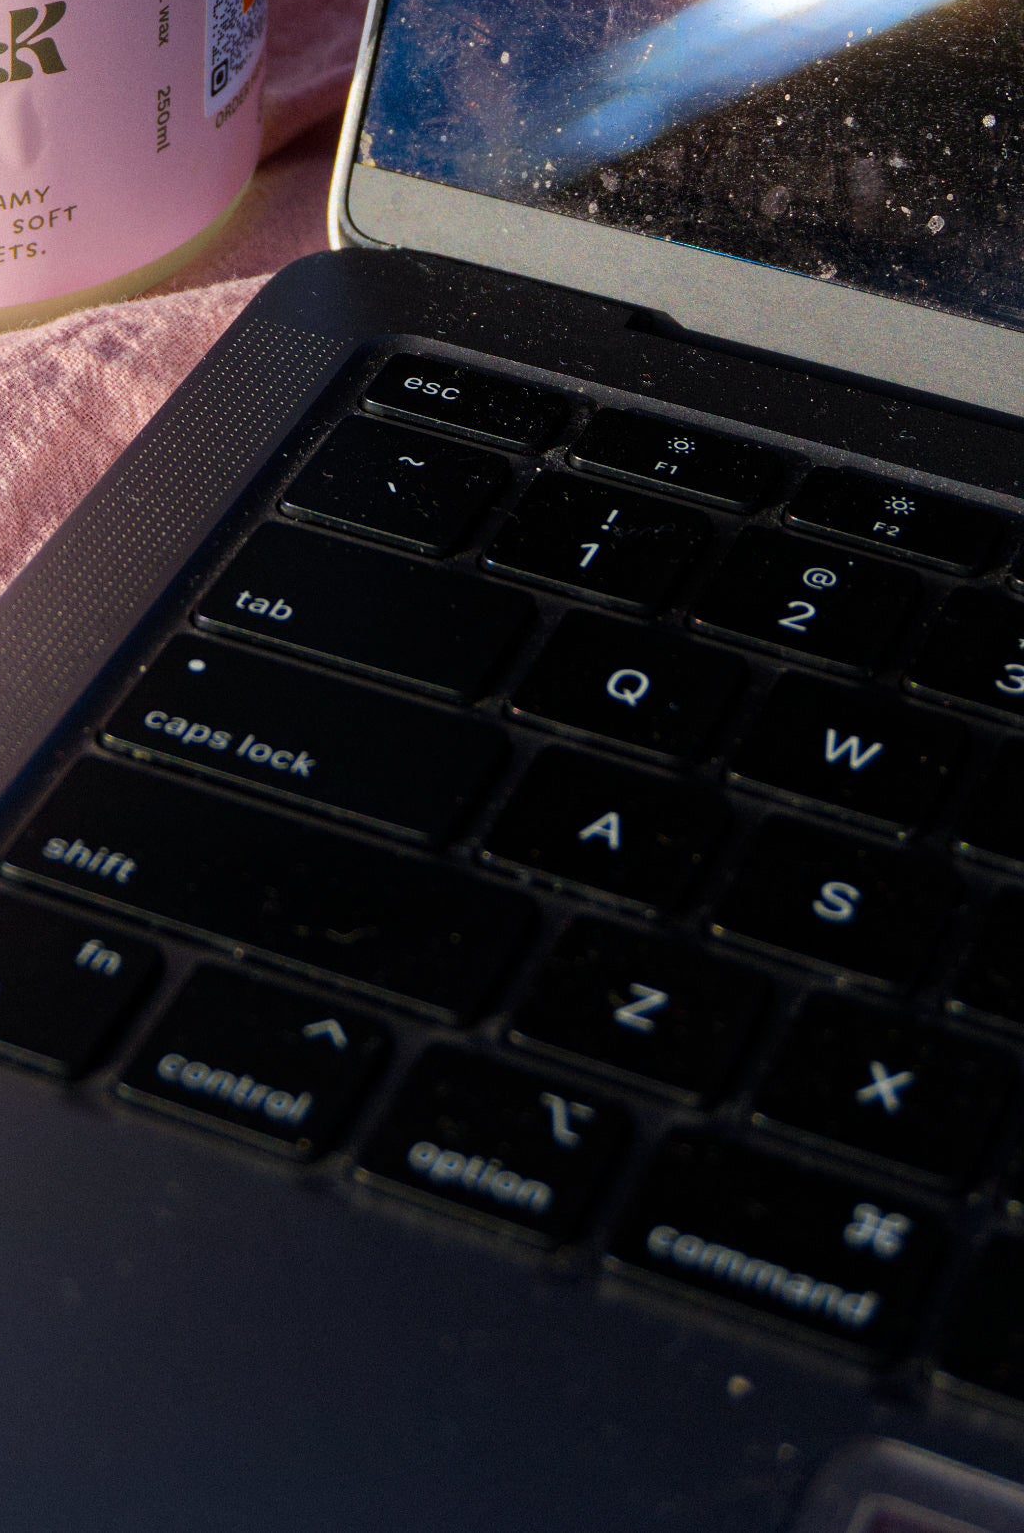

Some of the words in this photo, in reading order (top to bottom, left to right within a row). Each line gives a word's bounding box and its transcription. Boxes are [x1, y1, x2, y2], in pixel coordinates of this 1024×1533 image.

[158, 6, 170, 48] wax
[156, 85, 171, 154] 250ml
[12, 205, 79, 235] SOFT
[403, 376, 461, 401] esc
[654, 460, 680, 476] F1
[872, 521, 901, 537] F2
[580, 542, 600, 568] 1
[802, 566, 838, 590] @
[236, 589, 294, 622] tab
[777, 600, 817, 632] 2
[606, 668, 650, 708] Q
[144, 710, 233, 751] caps
[235, 733, 317, 778] lock
[823, 727, 884, 771] W
[578, 810, 623, 851] A
[43, 835, 137, 885] shift
[812, 880, 862, 923] S
[75, 938, 123, 976] fn
[613, 982, 669, 1033] Z
[156, 1052, 313, 1124] control
[856, 1060, 914, 1114] X
[407, 1140, 554, 1211] option
[647, 1224, 880, 1326] command
